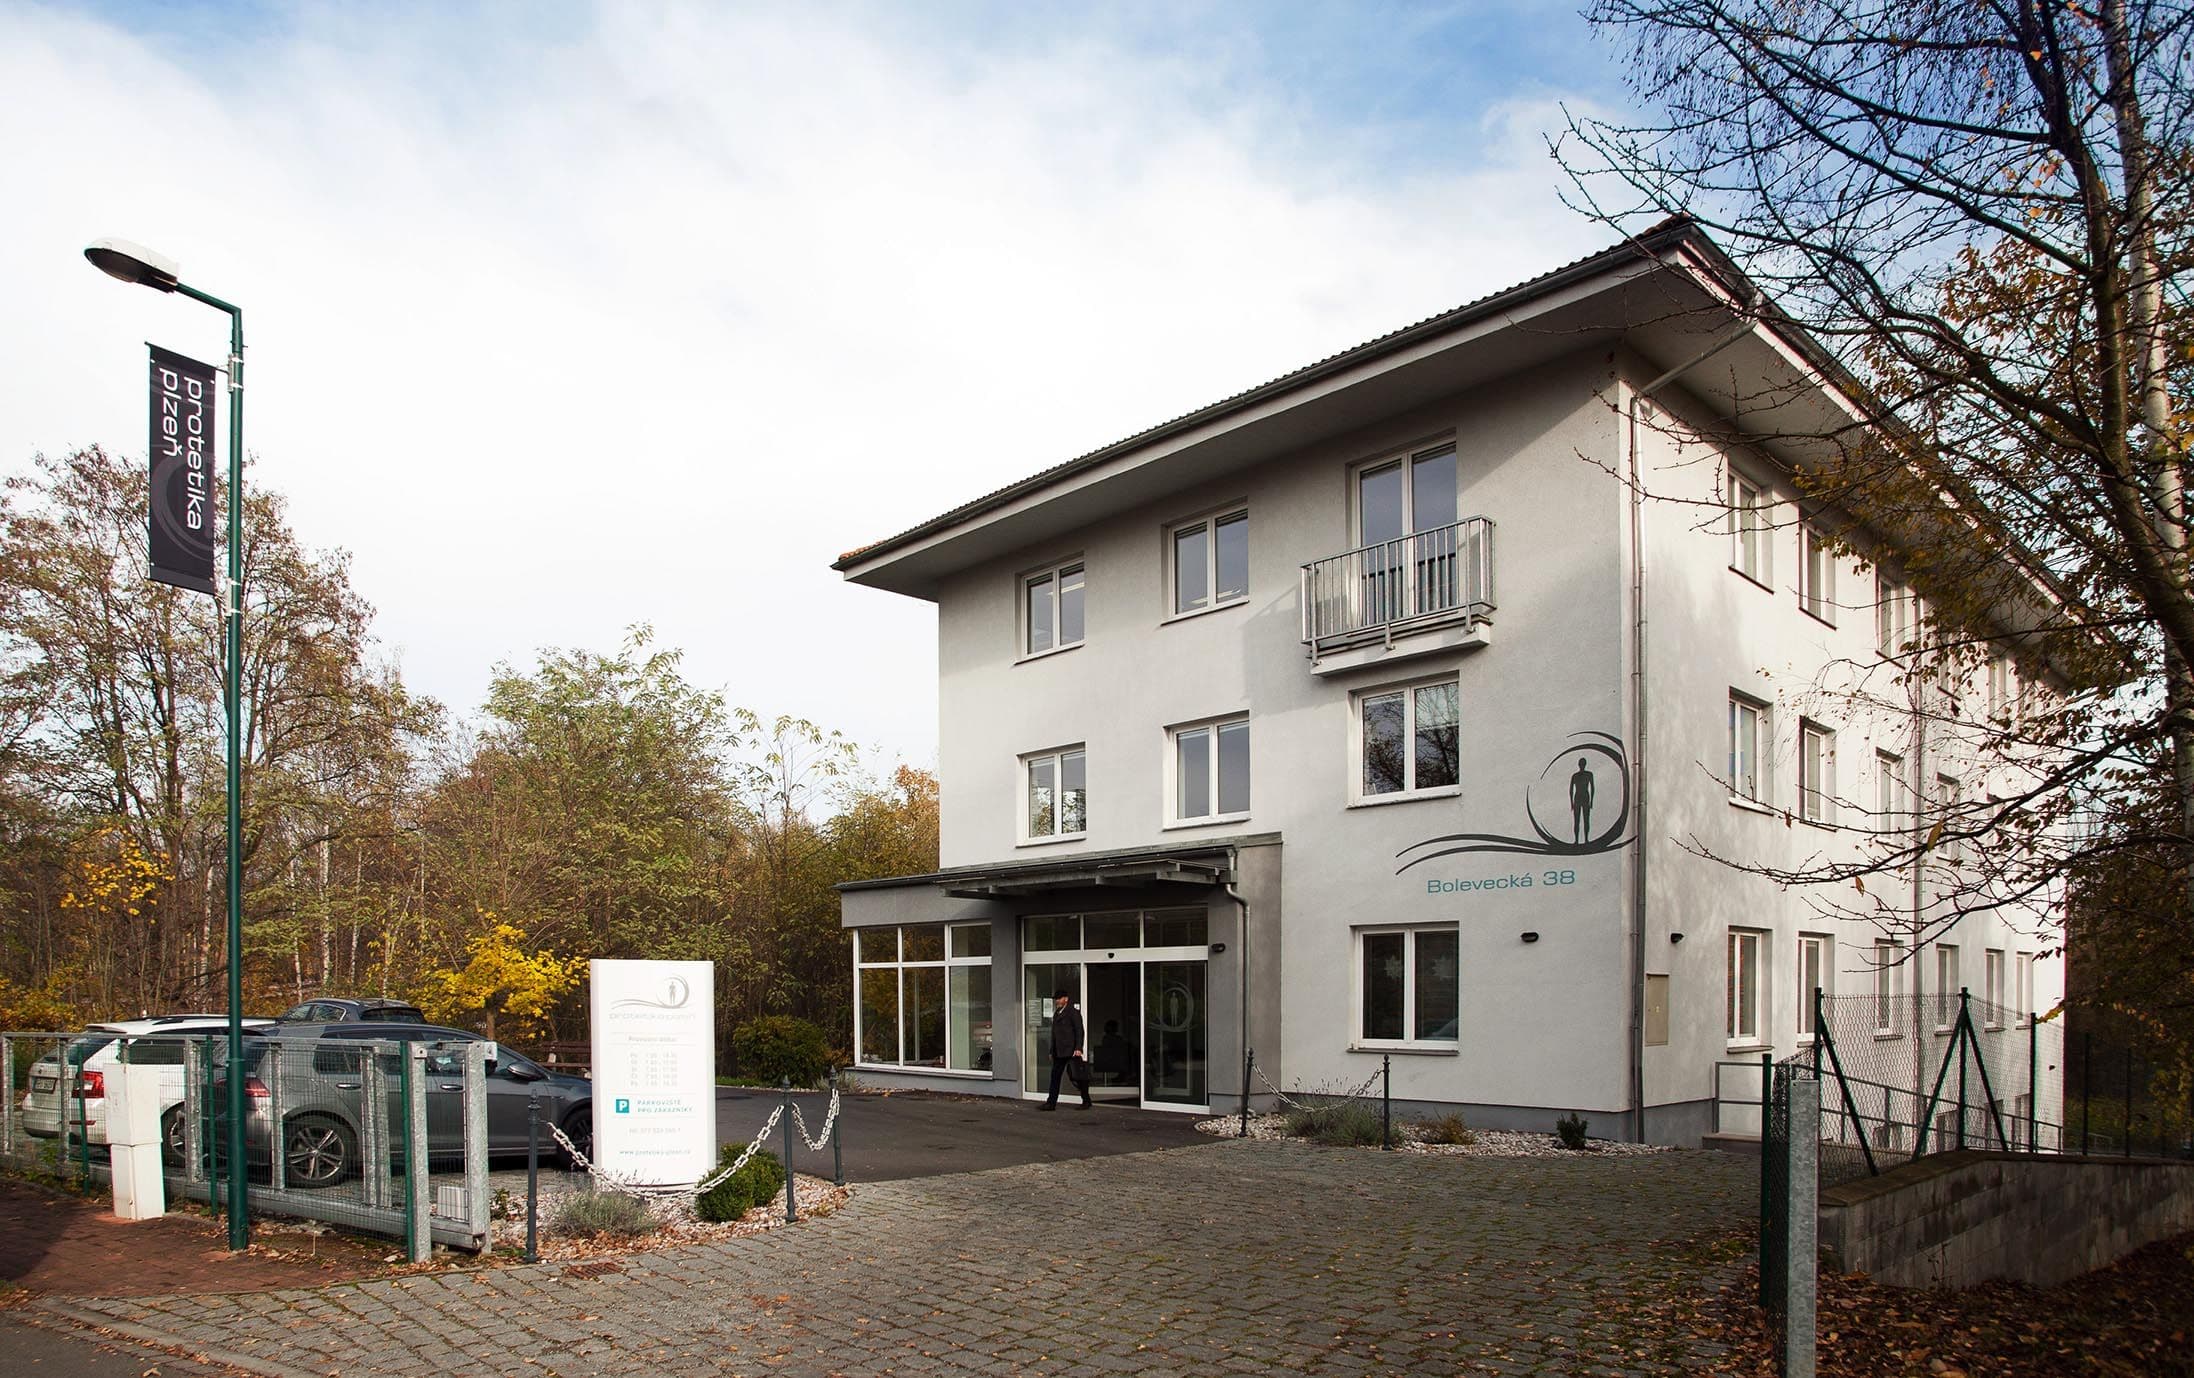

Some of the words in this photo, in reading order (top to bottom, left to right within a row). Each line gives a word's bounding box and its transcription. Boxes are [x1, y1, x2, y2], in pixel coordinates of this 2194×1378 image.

[159, 367, 182, 457] plzeň
[184, 376, 206, 530] protetika
[1427, 872, 1533, 894] Bolevecká
[1543, 870, 1575, 886] 38
